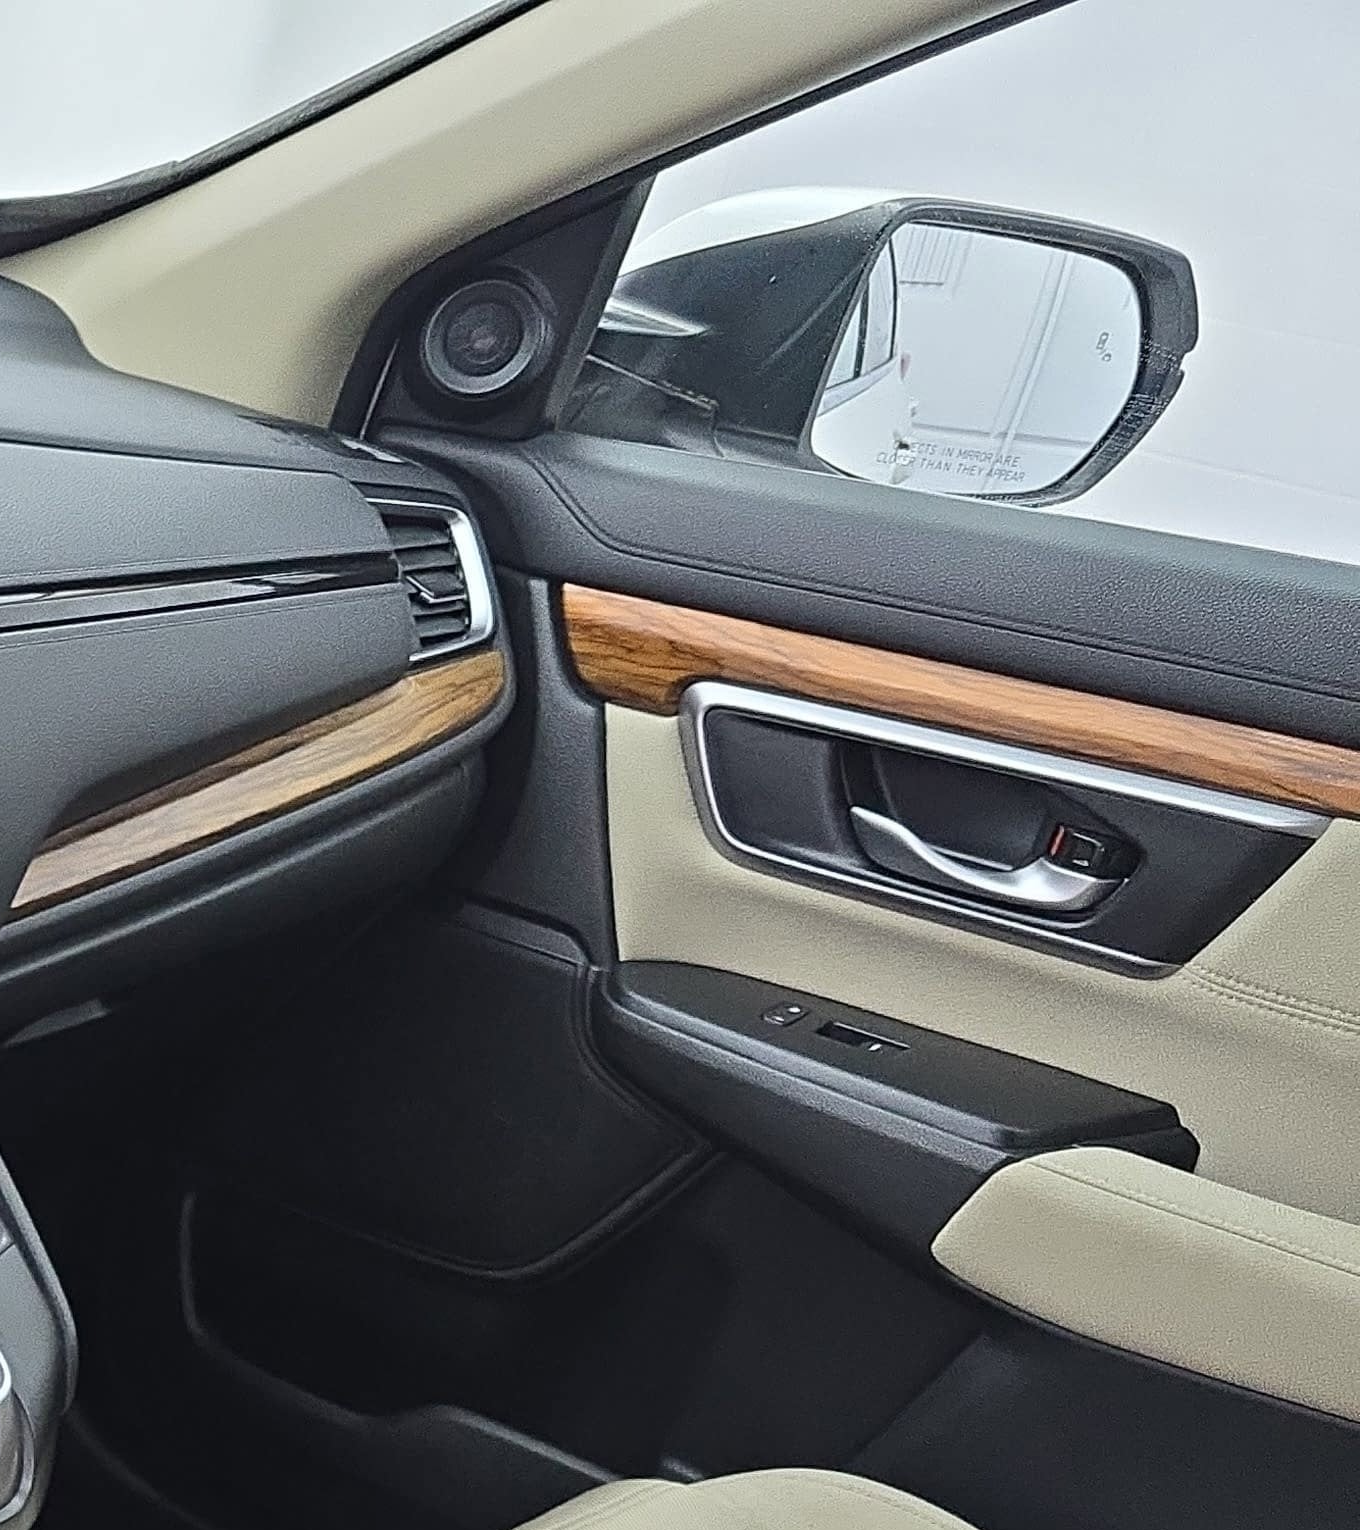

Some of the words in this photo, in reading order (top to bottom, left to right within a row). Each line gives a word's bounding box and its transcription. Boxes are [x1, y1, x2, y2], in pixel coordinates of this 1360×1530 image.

[940, 447, 955, 458] IN
[957, 450, 993, 463] MIRROR
[993, 454, 1021, 468] ARE
[919, 458, 953, 472] THAN
[956, 463, 984, 477] THEY
[985, 467, 1025, 482] APPEAR
